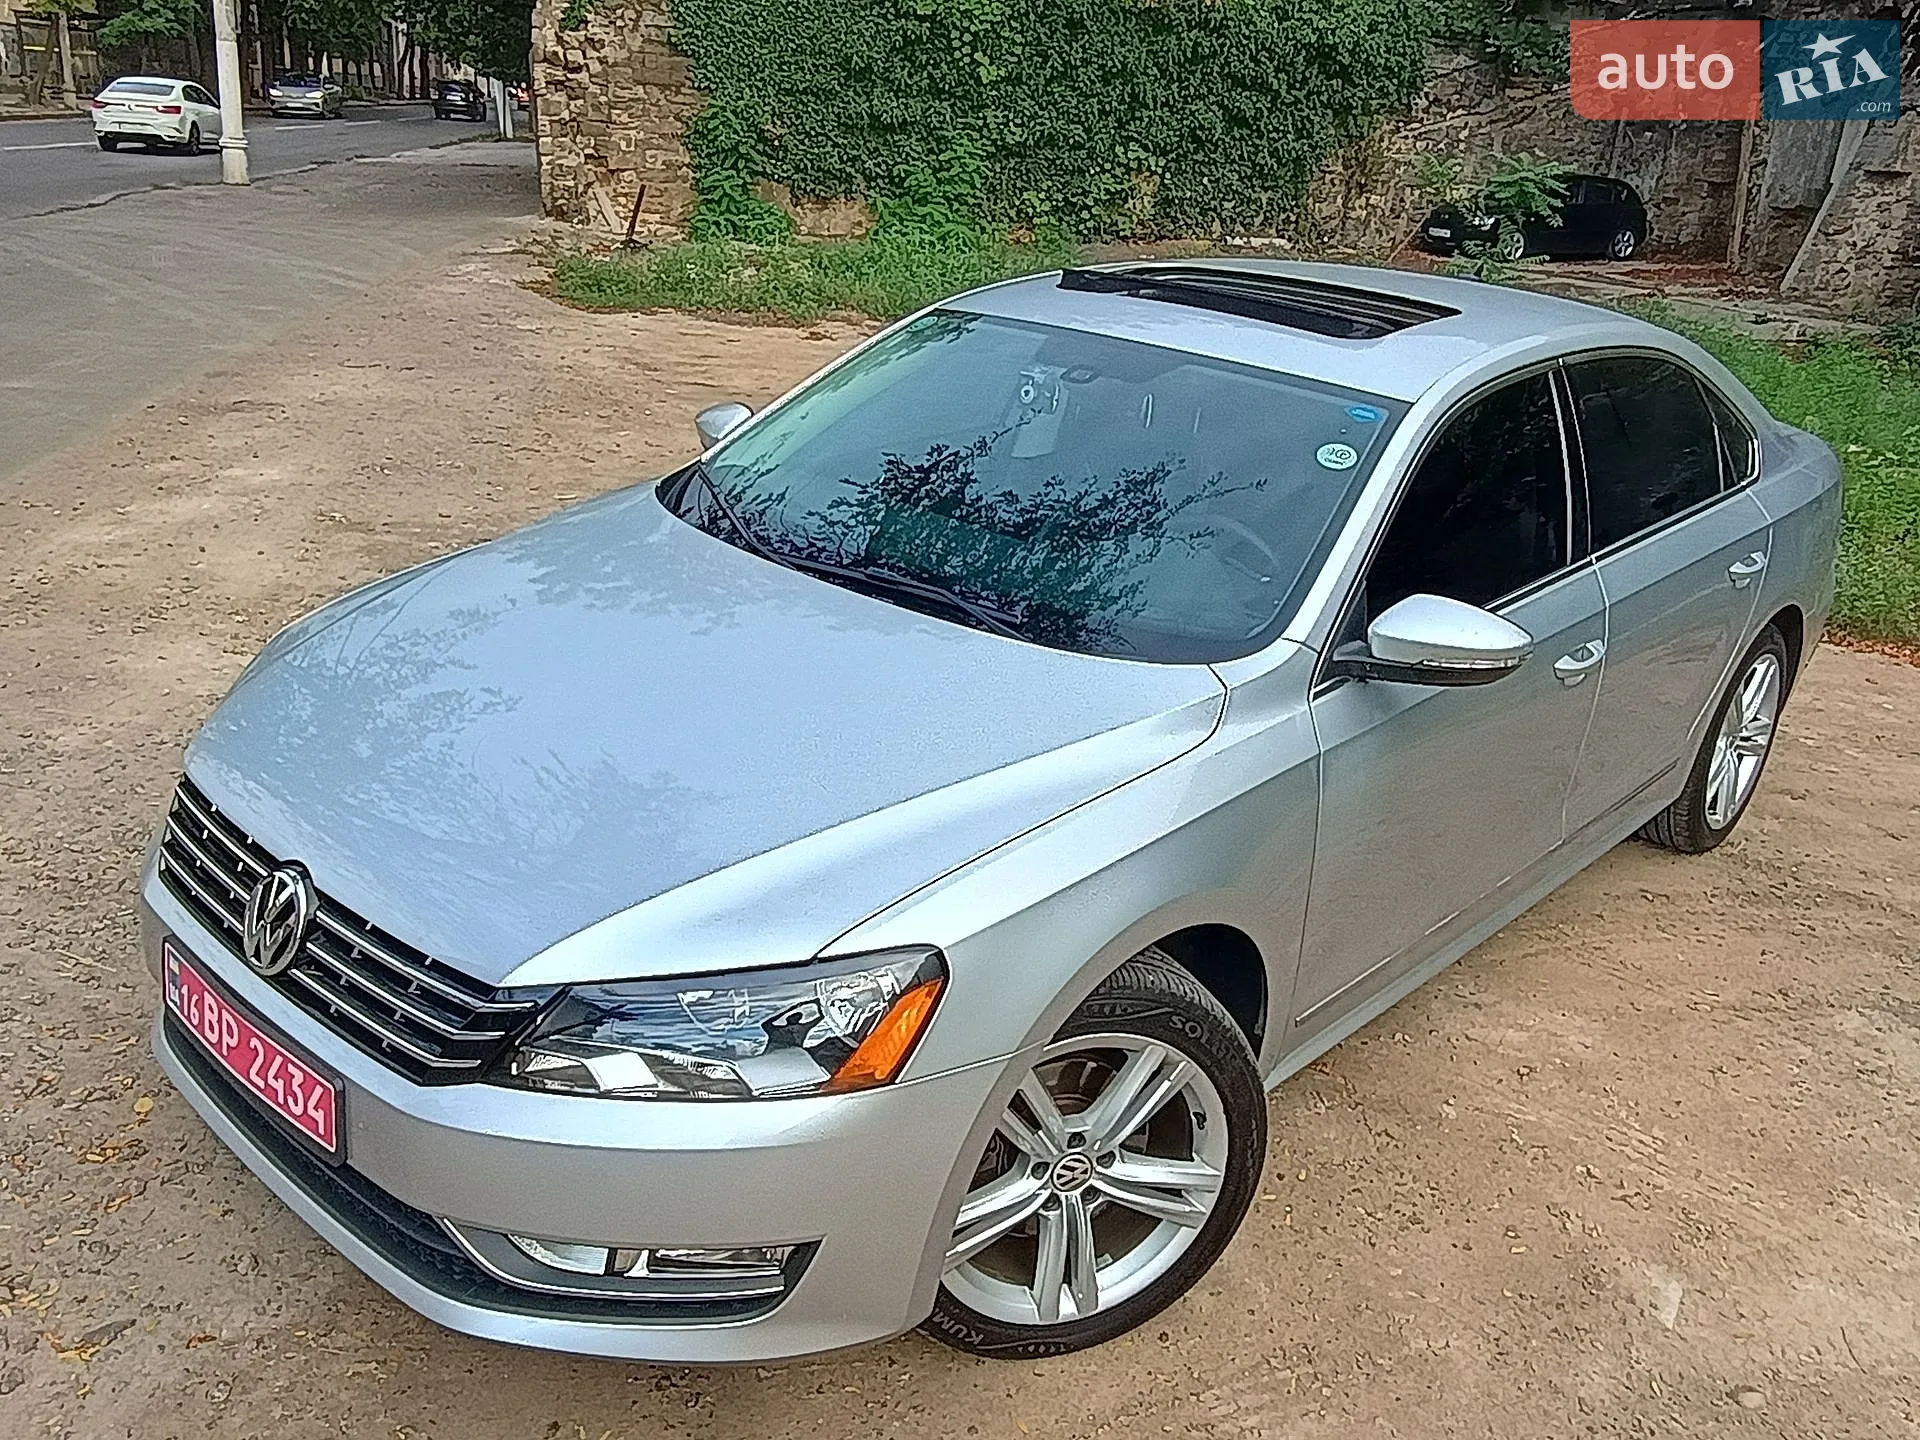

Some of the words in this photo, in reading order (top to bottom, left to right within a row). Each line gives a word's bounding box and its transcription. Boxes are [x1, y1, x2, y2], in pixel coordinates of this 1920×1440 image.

[181, 984, 199, 1026] 16
[204, 990, 239, 1057] BP
[249, 1037, 325, 1136] 2434
[931, 1308, 985, 1346] KUM
